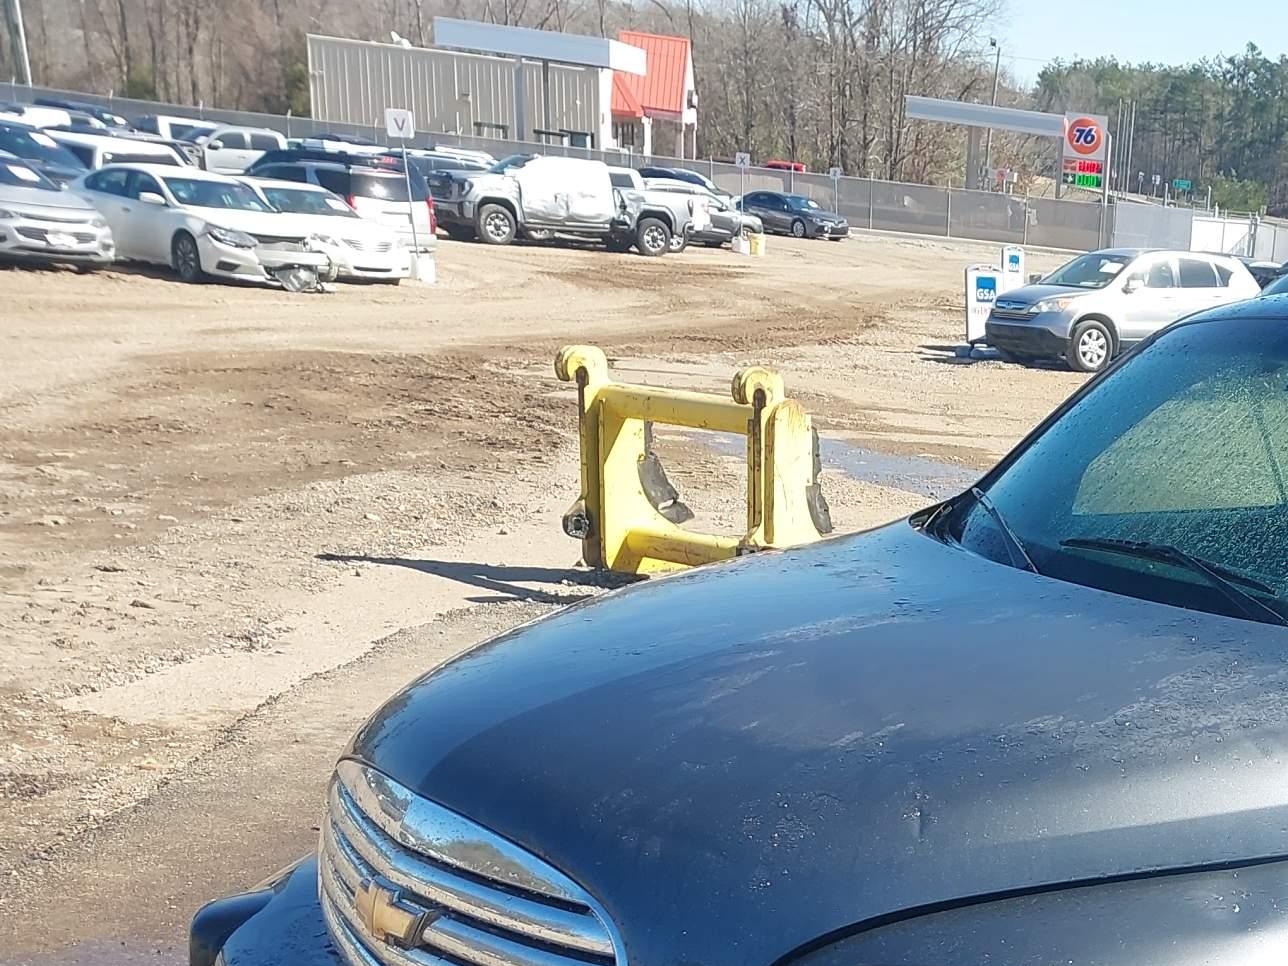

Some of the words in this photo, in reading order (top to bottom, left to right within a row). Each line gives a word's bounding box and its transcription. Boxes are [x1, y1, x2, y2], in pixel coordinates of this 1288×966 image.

[393, 117, 406, 131] V
[1073, 126, 1097, 146] 76
[739, 155, 747, 166] X
[977, 288, 996, 301] GSA
